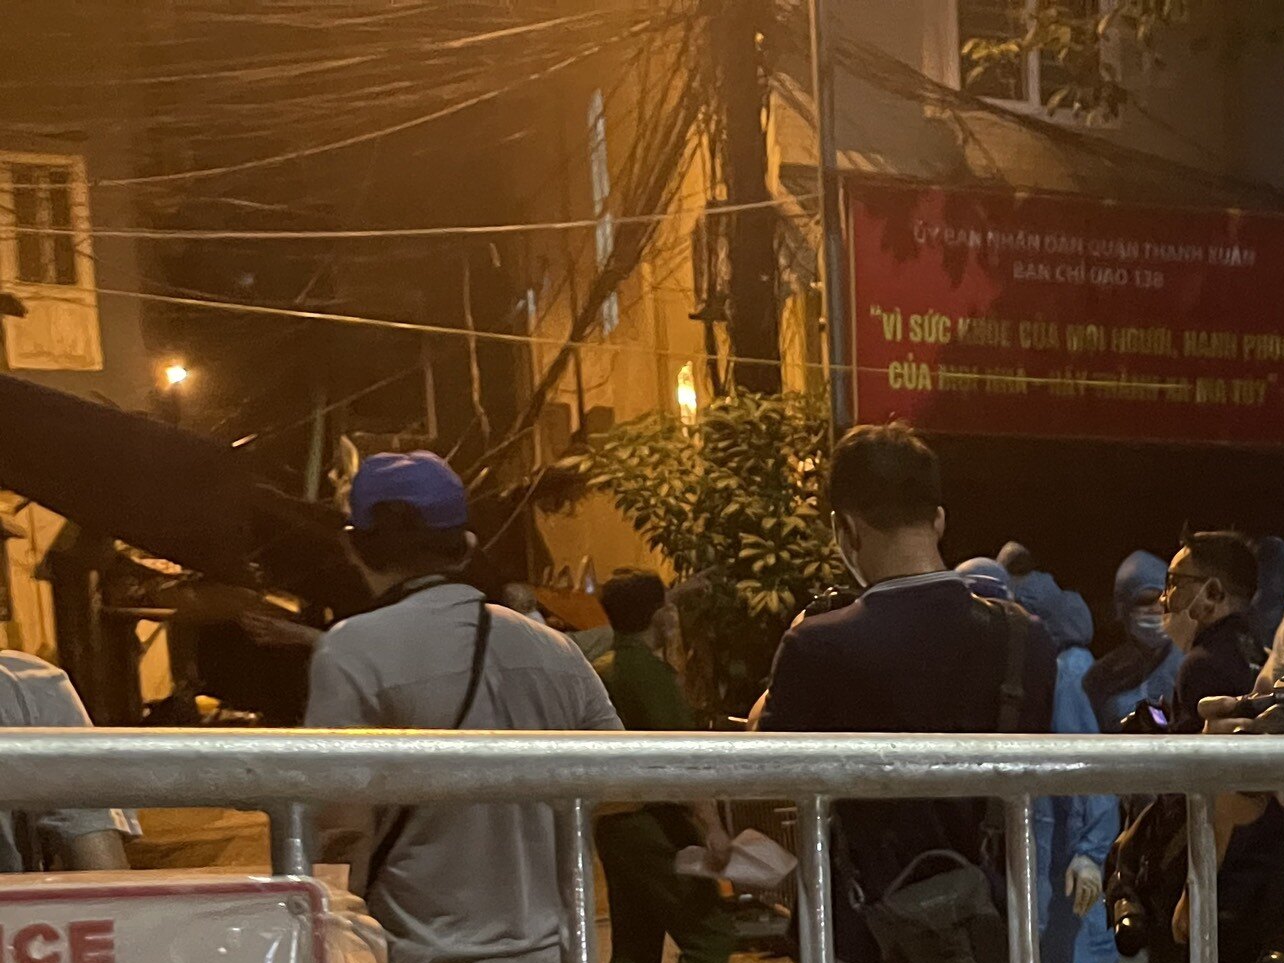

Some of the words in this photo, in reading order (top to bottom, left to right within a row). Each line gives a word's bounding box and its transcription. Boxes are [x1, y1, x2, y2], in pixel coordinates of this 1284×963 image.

[1013, 259, 1050, 281] BAN
[1135, 269, 1165, 290] 138
[909, 307, 951, 344] SỨC
[888, 352, 932, 392] CỦA
